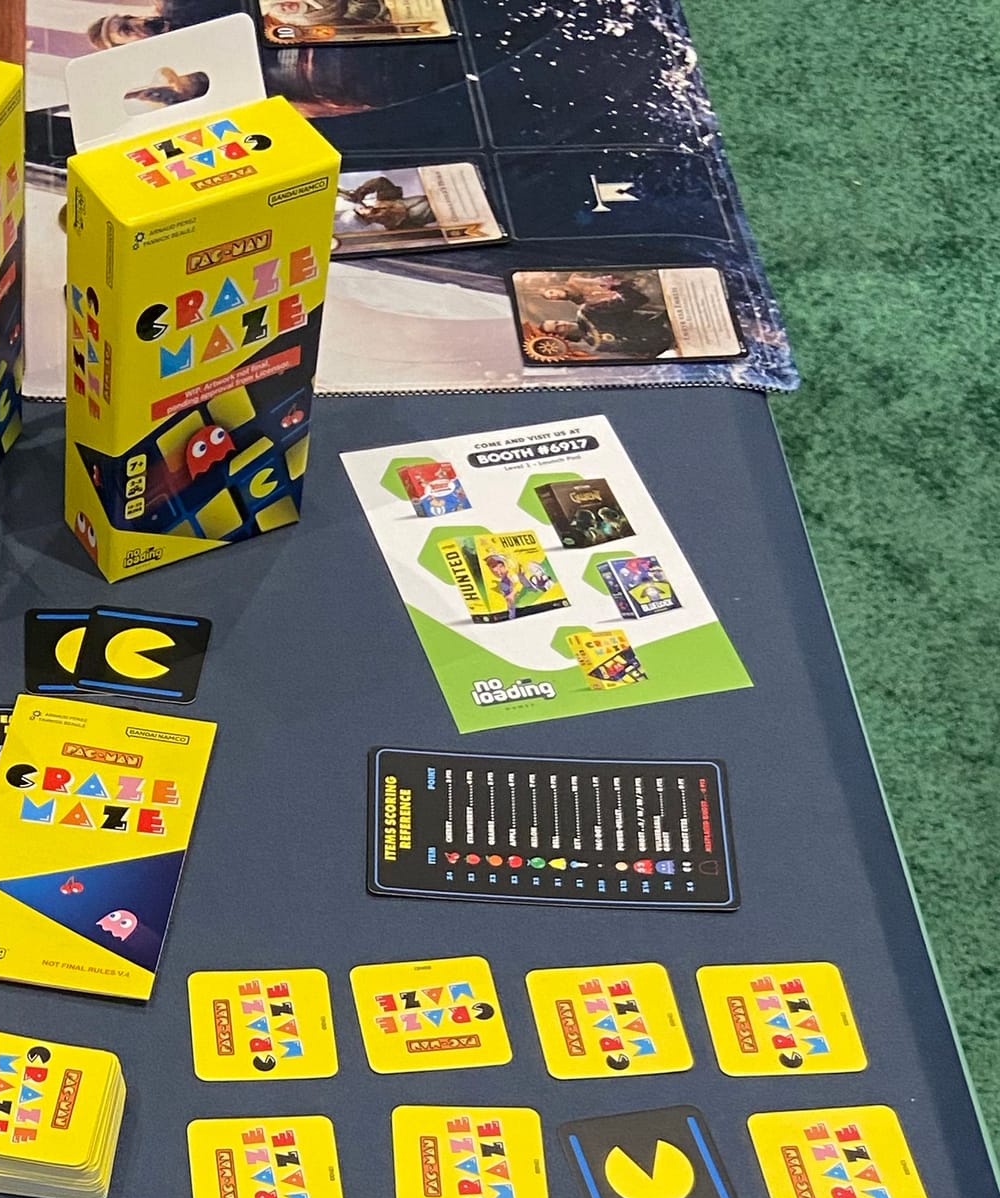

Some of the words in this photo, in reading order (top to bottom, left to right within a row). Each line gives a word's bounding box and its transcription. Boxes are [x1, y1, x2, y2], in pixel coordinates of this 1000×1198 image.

[277, 27, 295, 39] 10
[126, 120, 241, 167] MAZE
[138, 134, 272, 188] CRAZE
[192, 167, 256, 190] PAC-MAN
[299, 181, 326, 194] NAMCO
[189, 232, 270, 272] PAC-MAN
[136, 245, 318, 341] CRAZE
[160, 293, 308, 378] MAZE
[528, 433, 551, 441] VISIT
[130, 460, 144, 470] 7+
[476, 448, 534, 465] BOOTH
[538, 439, 588, 455] #6917
[500, 533, 536, 548] HUNTED
[123, 548, 163, 568] loading
[449, 550, 481, 601] HUNTED
[472, 679, 556, 706] loading
[474, 678, 502, 691] no
[129, 728, 157, 739] BANDAI
[158, 733, 187, 743] NAMCO
[63, 745, 141, 766] PAC-MAN
[6, 764, 181, 806] CRAZE
[20, 794, 166, 835] MAZE
[385, 776, 397, 825] SCORING
[400, 789, 411, 849] REFERENCE
[385, 827, 396, 860] ITEMS
[42, 960, 60, 968] NOT
[61, 963, 87, 972] FINAL
[88, 967, 115, 975] RULES
[375, 982, 474, 1011] MAZE
[374, 1002, 494, 1034] CRAZE
[407, 1035, 480, 1052] PAC-MAN
[12, 1046, 51, 1143] CRAZE
[52, 1069, 82, 1129] PAC-MAN
